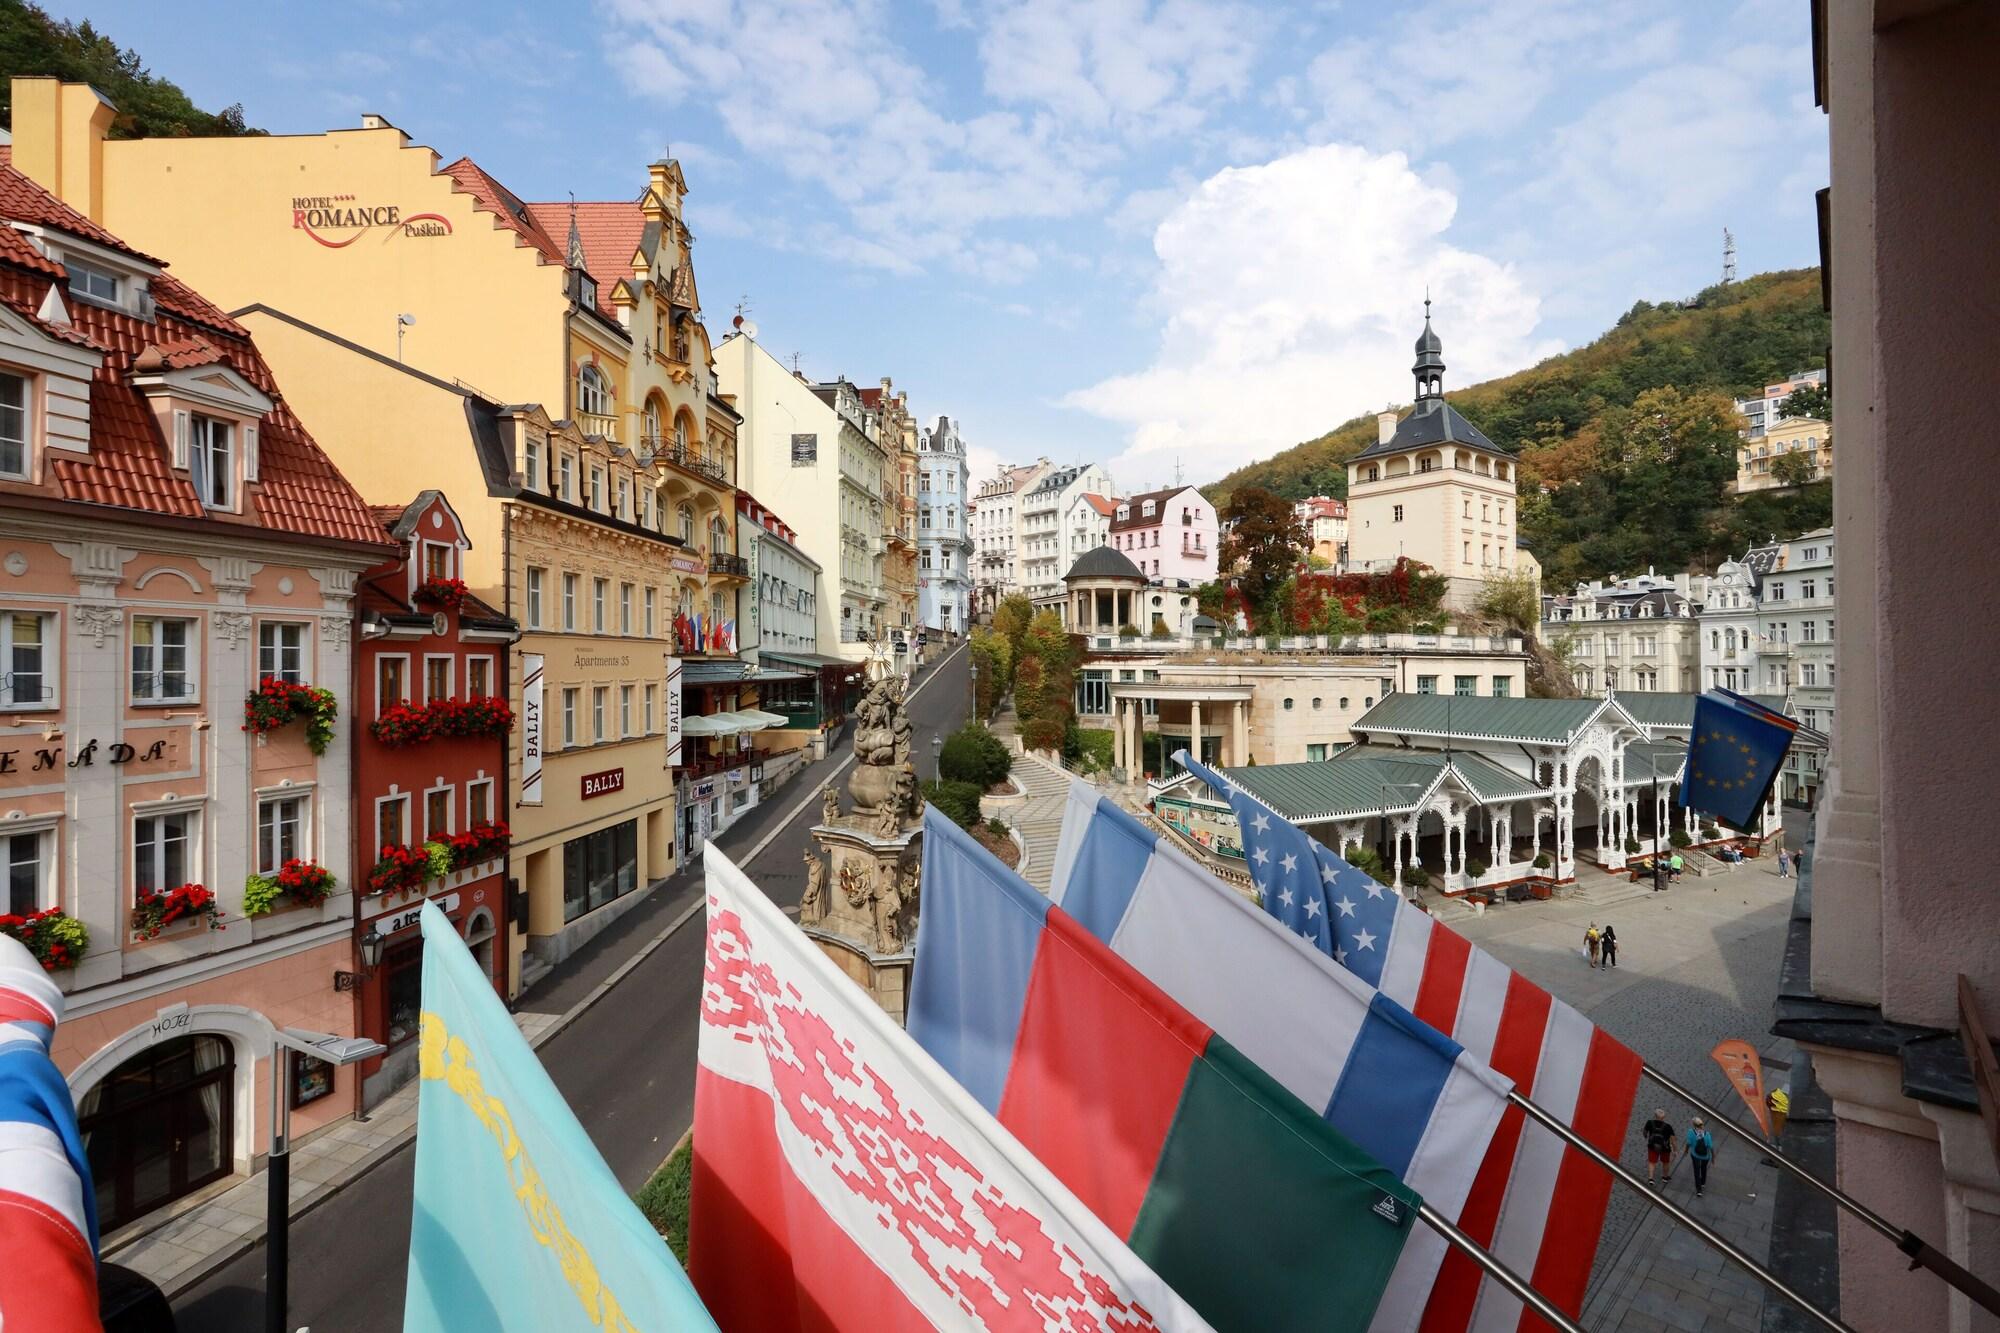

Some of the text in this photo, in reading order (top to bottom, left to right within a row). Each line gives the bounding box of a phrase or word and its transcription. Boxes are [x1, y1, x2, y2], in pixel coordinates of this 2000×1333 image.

[292, 197, 334, 209] HOTEL
[292, 206, 400, 229] ROMANCE
[404, 222, 446, 237] Puškin
[574, 654, 619, 670] Apartments
[670, 691, 679, 733] BALLY
[528, 701, 538, 758] BALLY
[585, 772, 622, 795] BALLY
[152, 1013, 190, 1038] HOTEL
